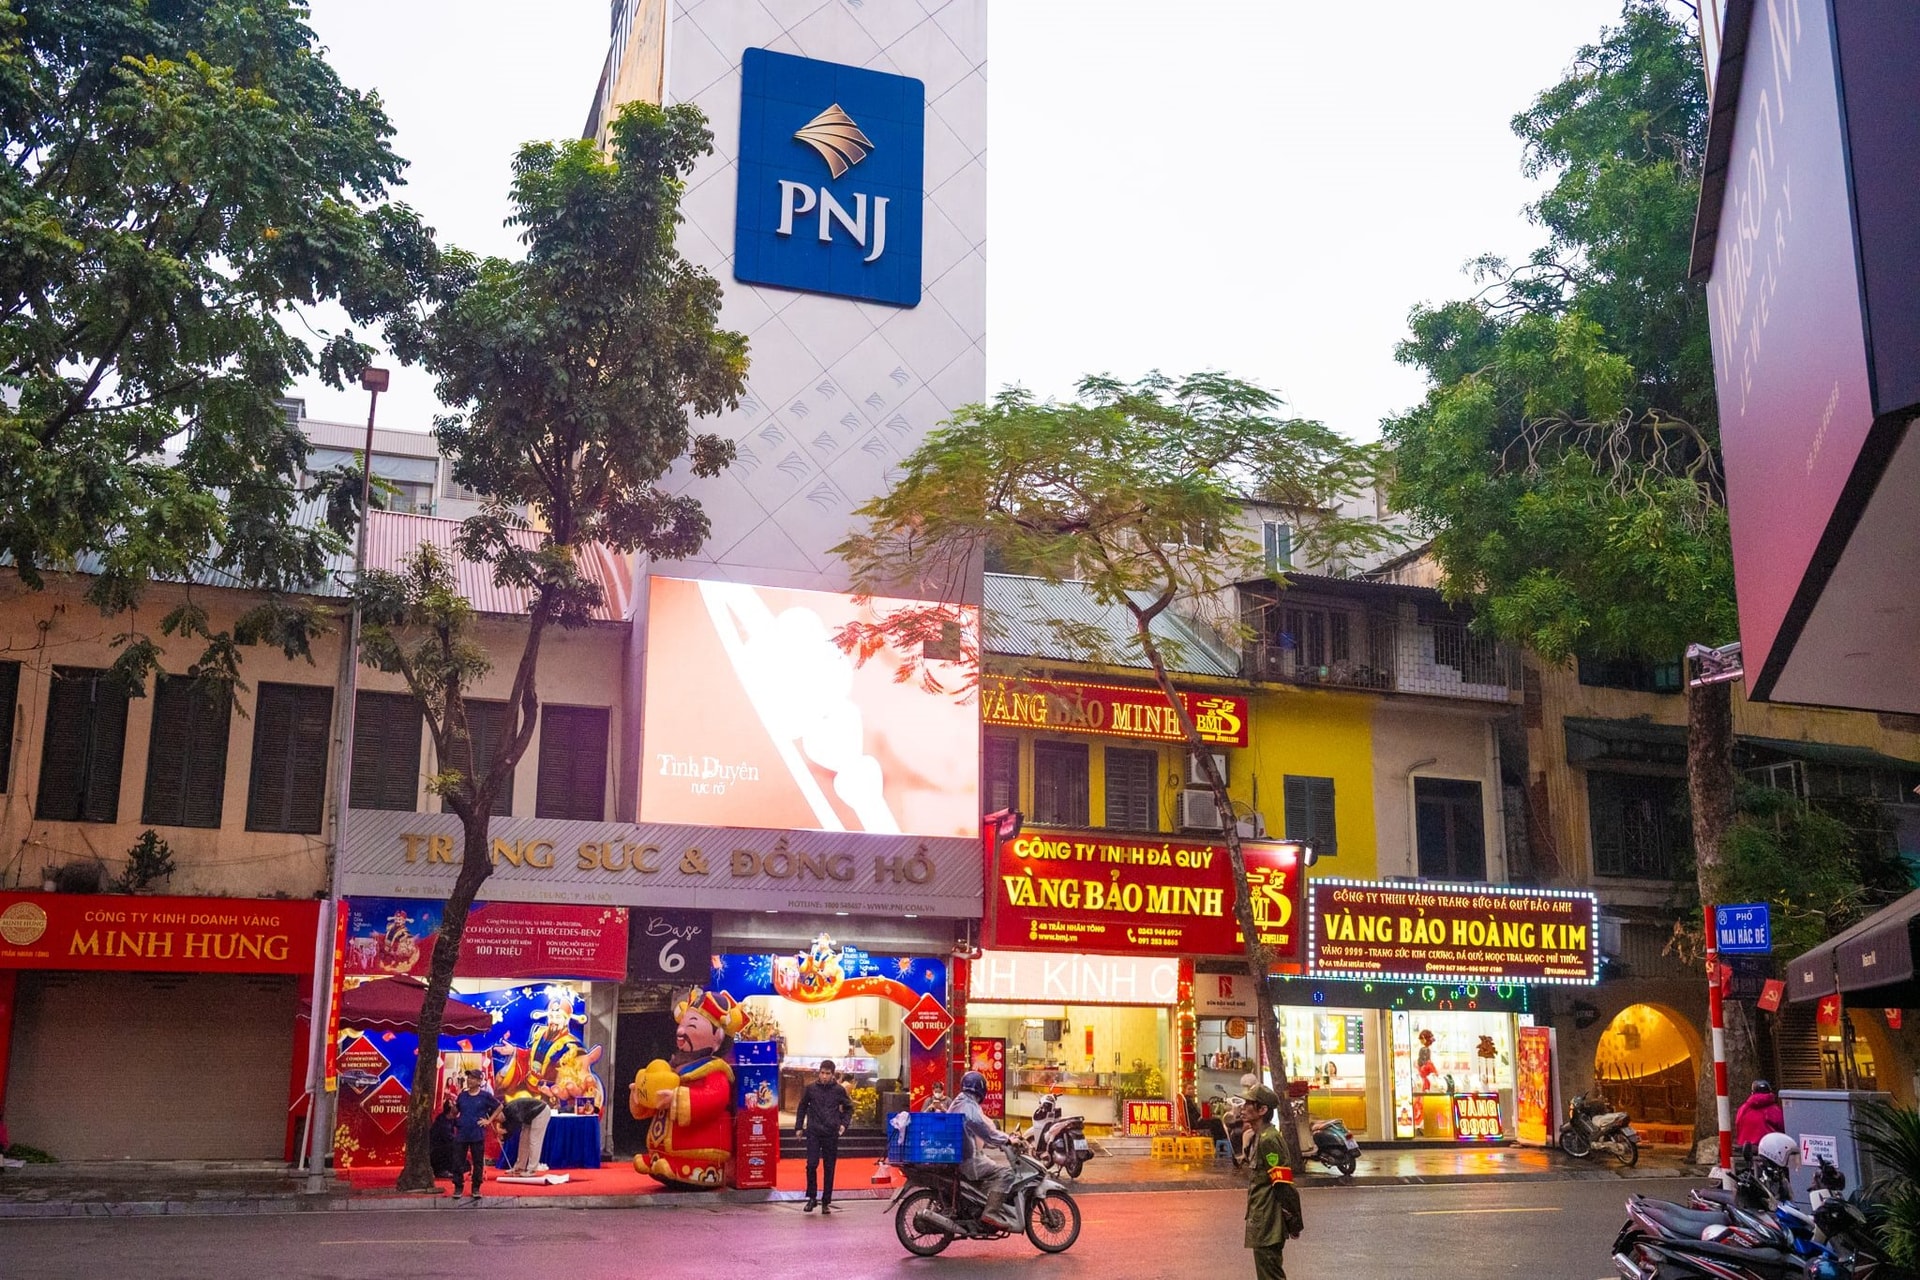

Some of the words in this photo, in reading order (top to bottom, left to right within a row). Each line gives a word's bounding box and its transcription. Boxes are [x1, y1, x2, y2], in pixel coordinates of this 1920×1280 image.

[776, 179, 890, 262] PNJ
[1739, 164, 1793, 417] JEWELRY
[1111, 702, 1181, 735] MINH
[701, 756, 760, 786] Duyên
[400, 833, 556, 869] TRNG
[577, 834, 661, 873] SỨC
[679, 845, 709, 877] &
[730, 836, 856, 882] ĐỒNG
[874, 843, 936, 884] HỒ
[1013, 836, 1071, 860] CÔNG
[1074, 843, 1096, 861] TY
[1098, 845, 1144, 865] TNHH
[1147, 844, 1172, 866] ĐÁ
[1175, 846, 1213, 869] QUÝ
[1002, 866, 1080, 909] VÀNG
[1083, 869, 1143, 912] BẢO
[1146, 885, 1224, 917] MINH
[1333, 889, 1364, 903] CÔNG
[1366, 892, 1377, 903] TY
[1379, 893, 1406, 905] TNHH
[1408, 892, 1436, 906] VÀNG
[1438, 896, 1470, 908] TRANG
[1472, 895, 1492, 909] SỨC
[1494, 895, 1507, 909] ĐÁ
[1509, 897, 1530, 911] QUÝ
[1531, 898, 1550, 912] BẢO
[1552, 902, 1572, 912] ANH
[788, 900, 823, 909] HOTLINE:
[867, 902, 936, 912] WWW.PNJ.COM.VN
[1736, 908, 1753, 921] PHỐ
[85, 909, 126, 922] CÔNG
[131, 912, 148, 923] TY
[153, 913, 186, 924] KINH
[190, 914, 238, 925] DOANH
[243, 914, 280, 926] VÀNG
[645, 916, 702, 941] Base
[478, 926, 493, 934] HỘI
[525, 927, 535, 935] XE
[536, 928, 601, 937] MERCEDES-BENZ
[1324, 908, 1393, 942] VÀNG
[1400, 908, 1446, 945] BẢO
[1452, 914, 1536, 948] HOÀNG
[1541, 923, 1586, 950] KIM
[1721, 929, 1736, 945] MAI
[1738, 923, 1754, 944] HẮC
[1755, 923, 1766, 944] ĐẾ
[68, 928, 174, 958] MINH
[183, 932, 290, 960] HƯNG
[476, 946, 492, 955] 100
[495, 946, 522, 957] TRIỆU
[548, 947, 584, 956] IPHONE
[587, 948, 596, 956] 17
[1321, 944, 1343, 955] VÀNG
[1344, 947, 1363, 956] 9999
[1394, 947, 1411, 958] SỨC
[1411, 950, 1427, 959] KIM
[659, 939, 685, 973] 6
[1044, 954, 1137, 998] KÍNH
[911, 1021, 924, 1030] 100
[925, 1020, 946, 1031] TRIỆU
[370, 1105, 384, 1113] 100
[1133, 1102, 1168, 1121] VÀNG
[1457, 1096, 1497, 1117] VÀNG
[1460, 1118, 1498, 1135] 9999
